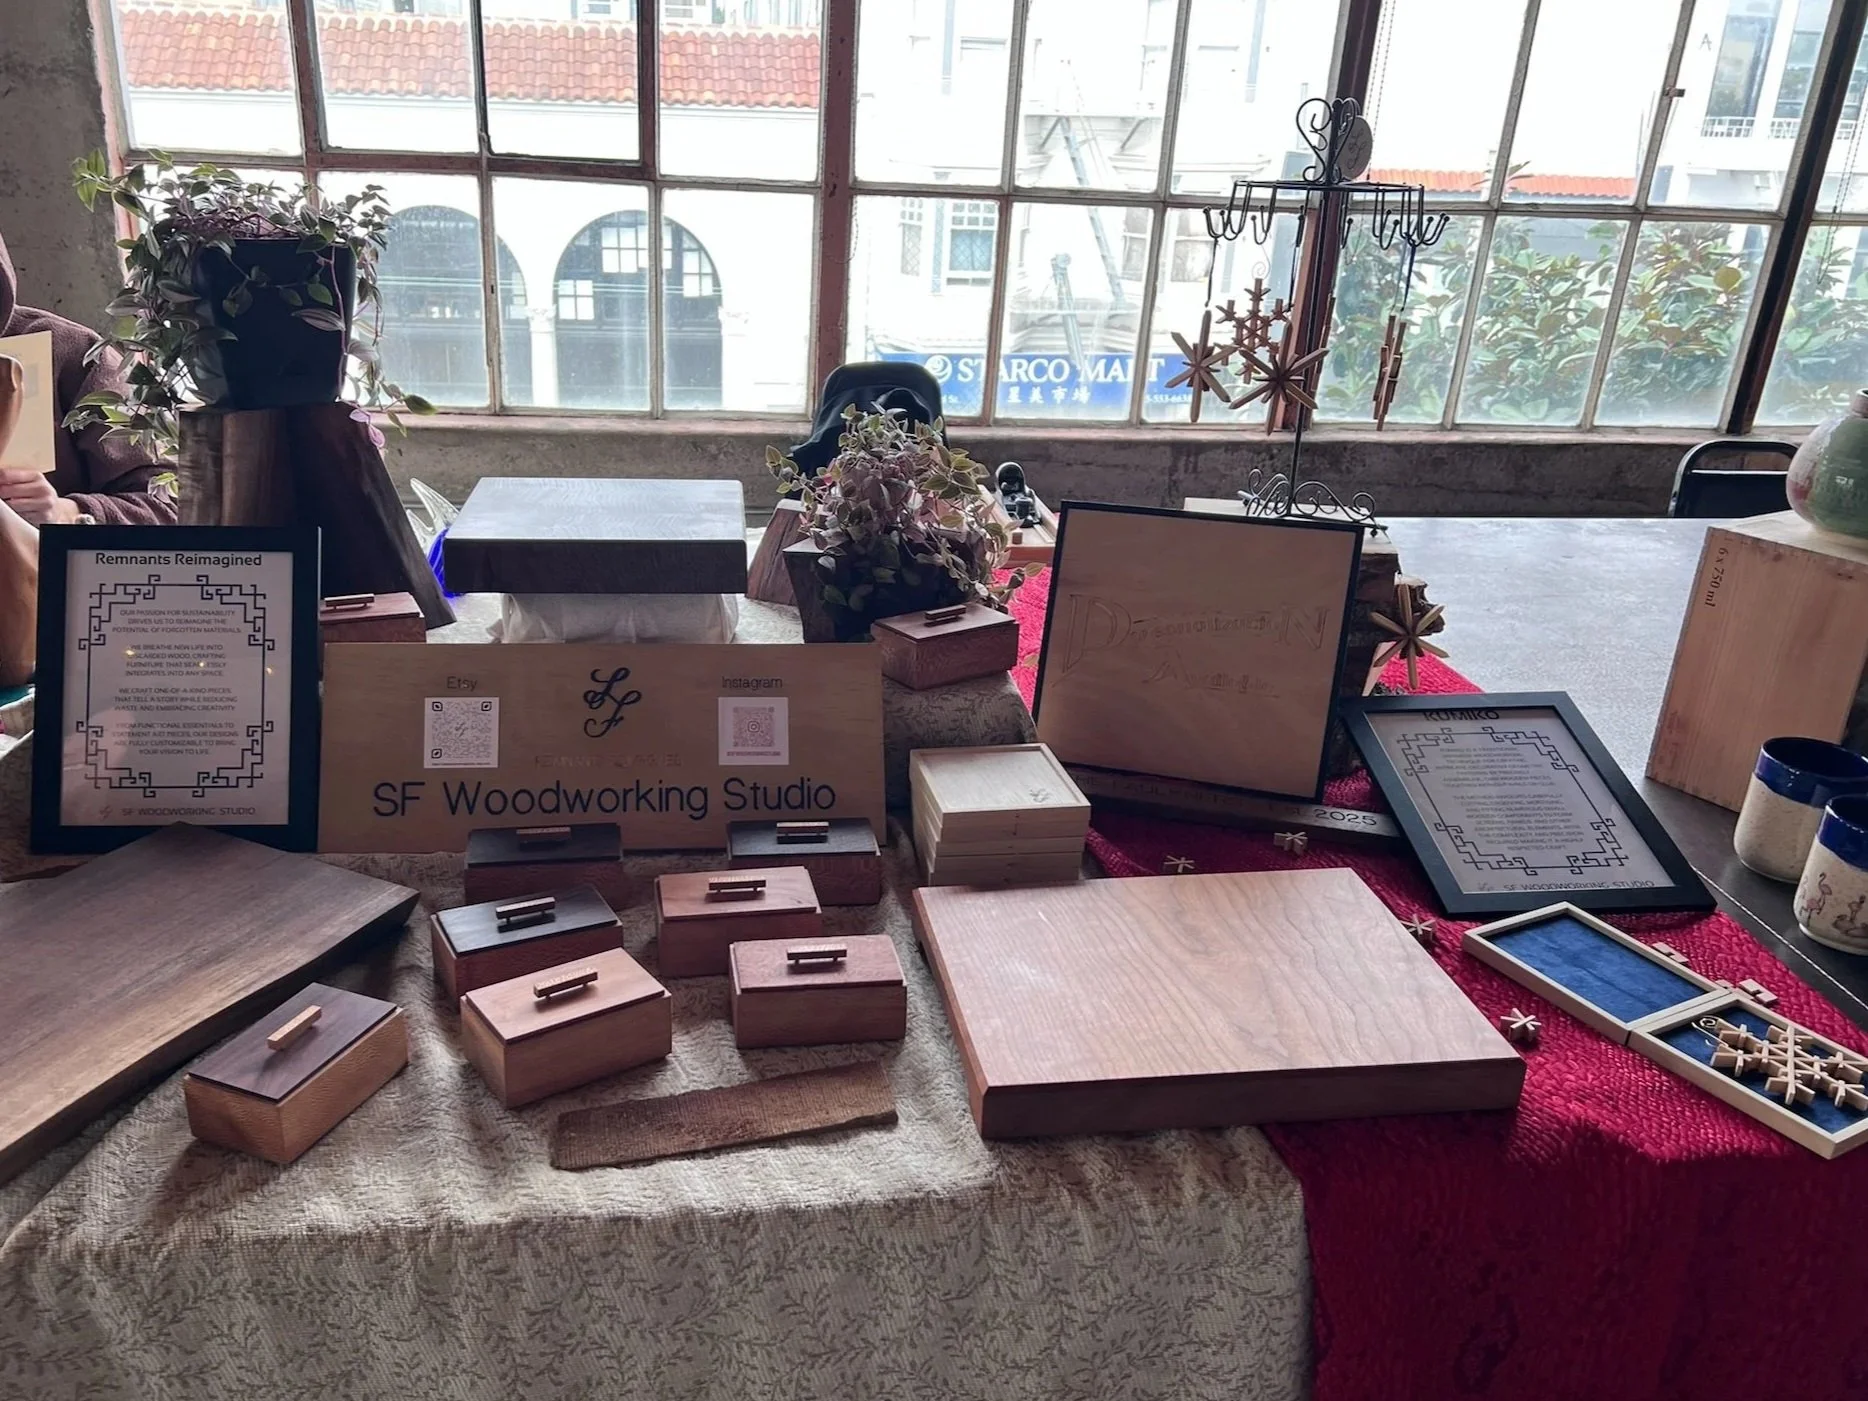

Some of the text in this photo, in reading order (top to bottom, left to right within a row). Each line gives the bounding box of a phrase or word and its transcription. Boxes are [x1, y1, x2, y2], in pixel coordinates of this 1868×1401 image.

[1719, 547, 1729, 555] 6
[95, 552, 262, 568] Remnants Reimagined
[1711, 567, 1725, 589] 750
[1705, 590, 1716, 608] ml
[447, 676, 477, 691] Etsy
[722, 676, 783, 690] Instagram
[1423, 710, 1500, 721] KUMIKO
[372, 777, 836, 820] SF Woodworking Studio
[121, 807, 134, 816] SF
[138, 807, 216, 816] WOODWORKING
[219, 807, 256, 816] STUDIO
[1313, 808, 1378, 827] 2025
[1521, 881, 1609, 891] WOODWORKING
[1612, 880, 1656, 889] STUDIO
